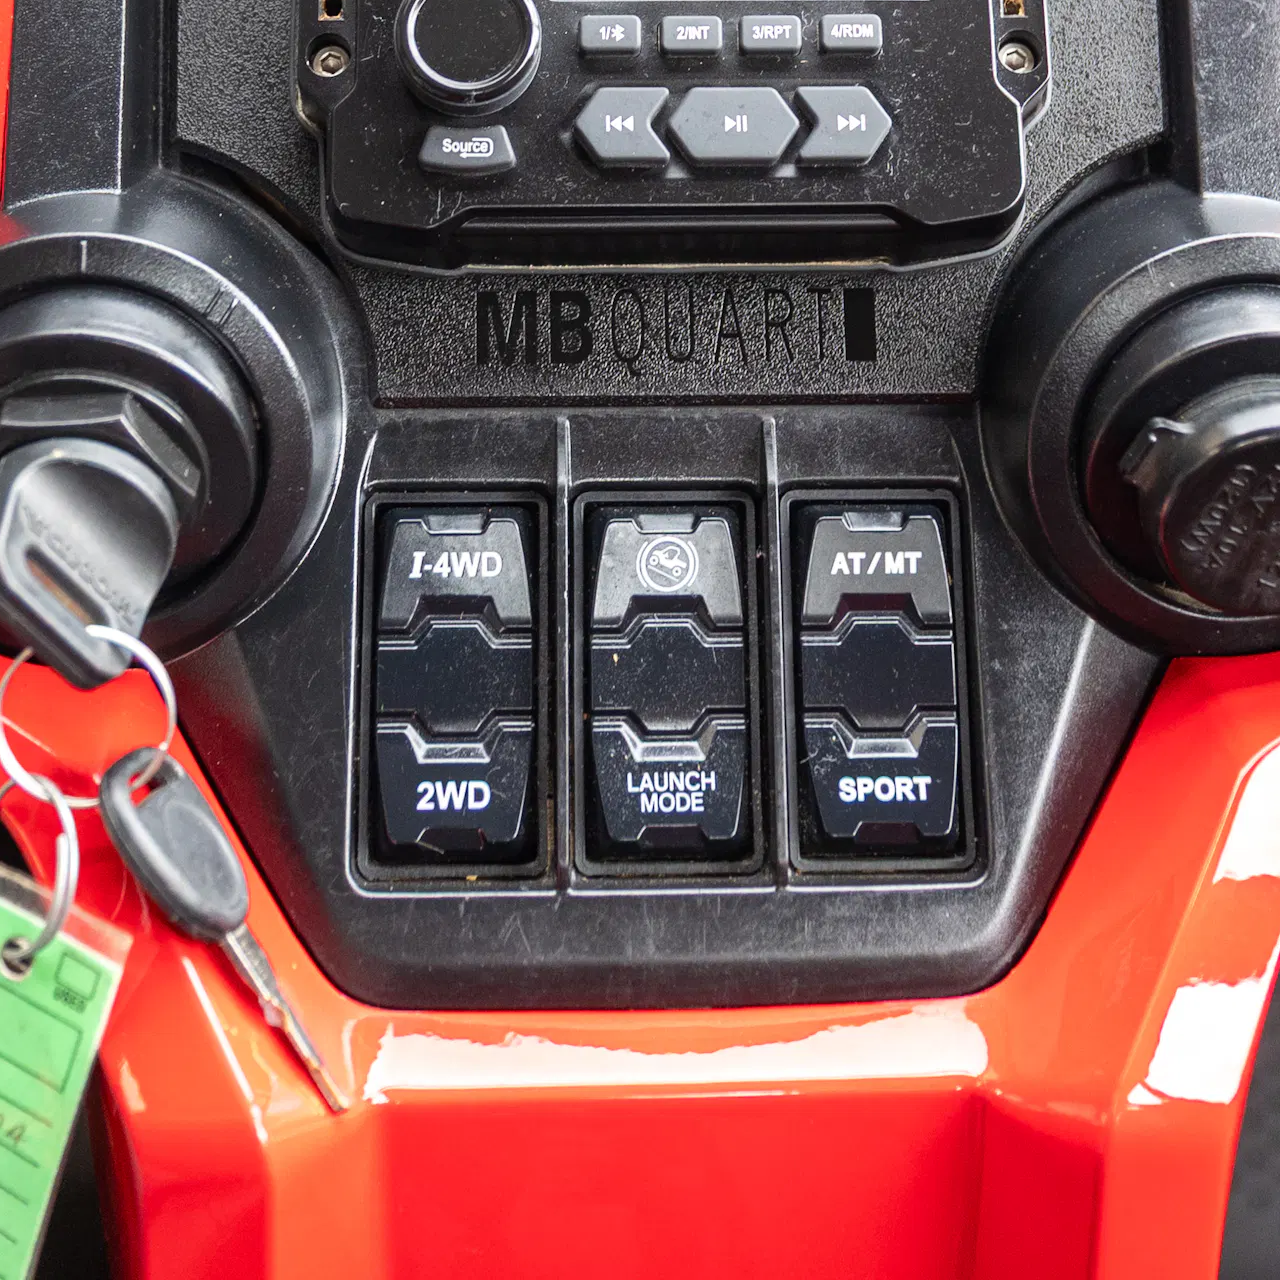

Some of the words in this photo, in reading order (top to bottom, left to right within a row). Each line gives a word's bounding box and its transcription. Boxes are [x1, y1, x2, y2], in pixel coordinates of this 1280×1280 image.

[676, 26, 710, 41] 2/INT
[752, 25, 792, 40] 3/RPT
[830, 24, 874, 39] 4/RDM
[442, 138, 489, 154] Source
[409, 550, 503, 580] I-4WD
[830, 550, 923, 576] AT/MT
[627, 771, 717, 794] LAUNCH
[838, 776, 932, 803] SPORT
[416, 781, 492, 811] 2WD
[640, 791, 705, 814] MODE
